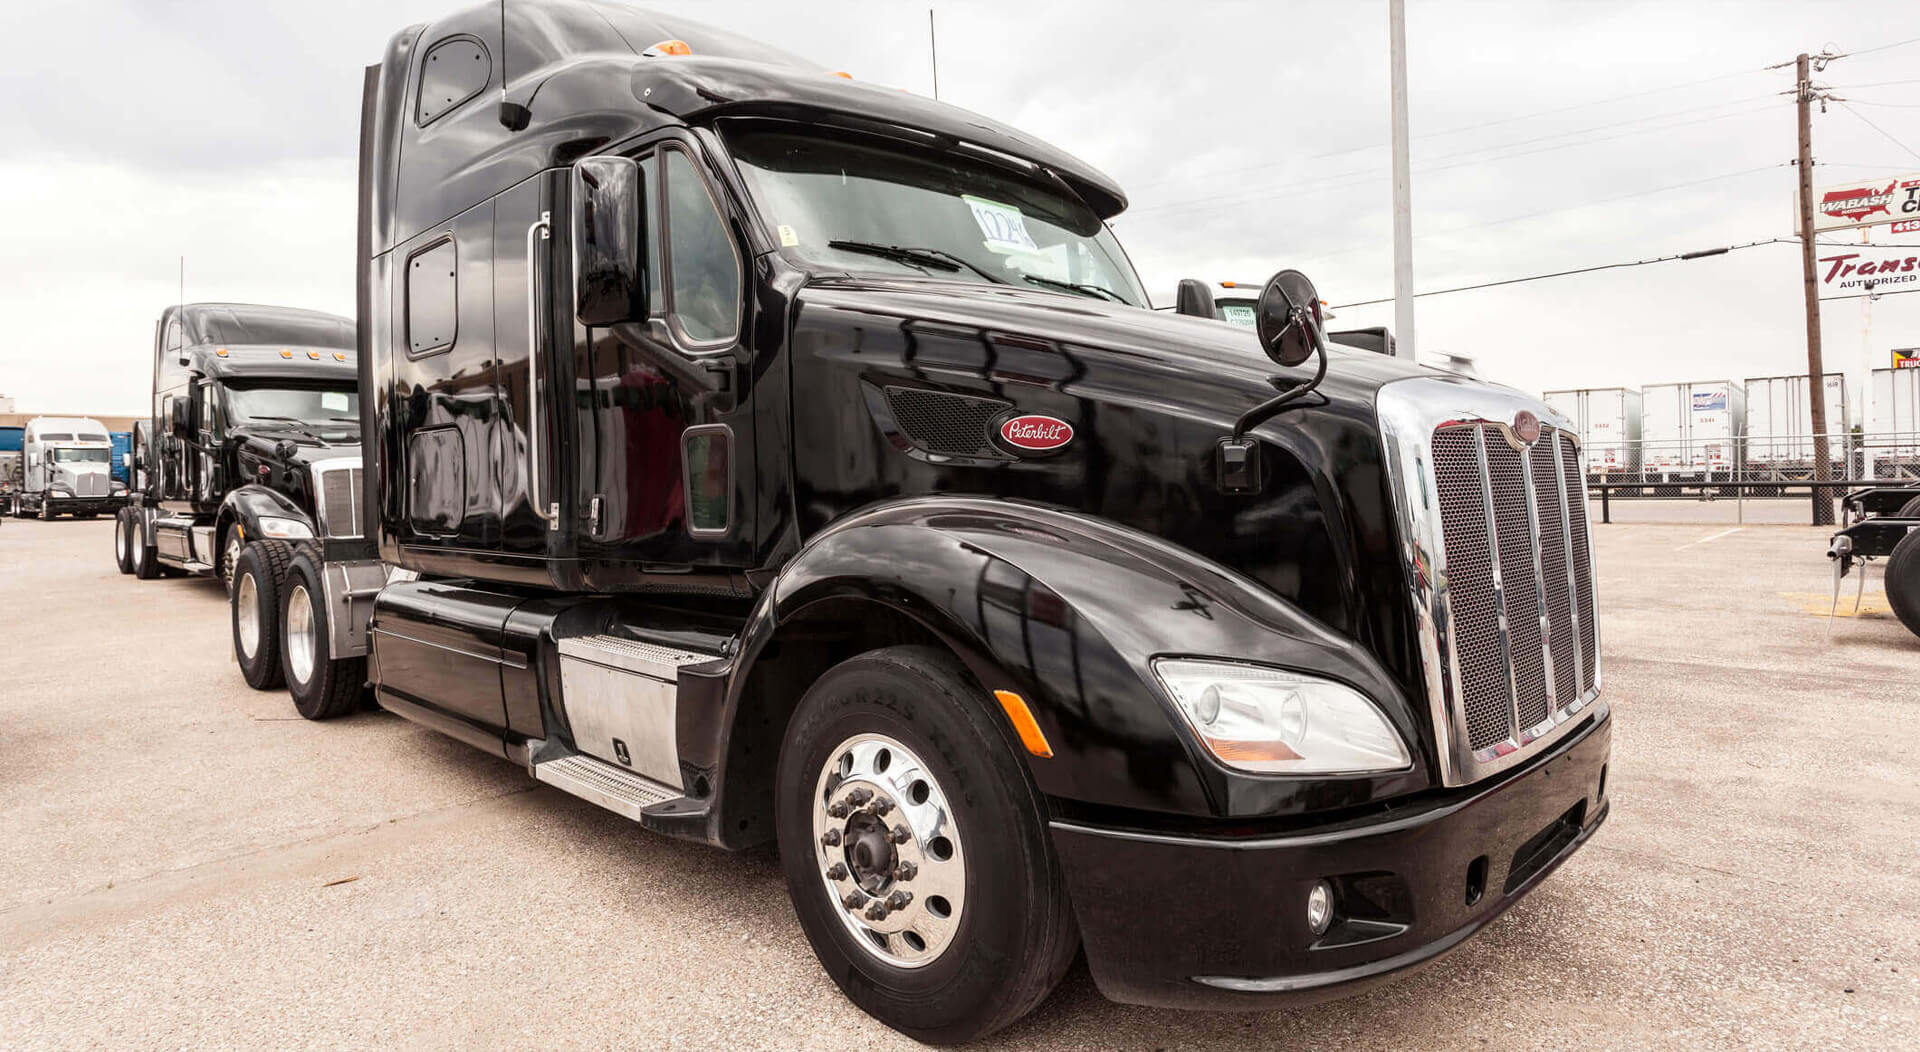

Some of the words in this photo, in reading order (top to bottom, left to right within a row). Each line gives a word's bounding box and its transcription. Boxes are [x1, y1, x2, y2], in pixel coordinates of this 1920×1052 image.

[1905, 186, 1920, 200] T
[1821, 194, 1893, 212] WABASH
[1818, 253, 1920, 284] Trans
[1009, 421, 1066, 440] Peterbilt
